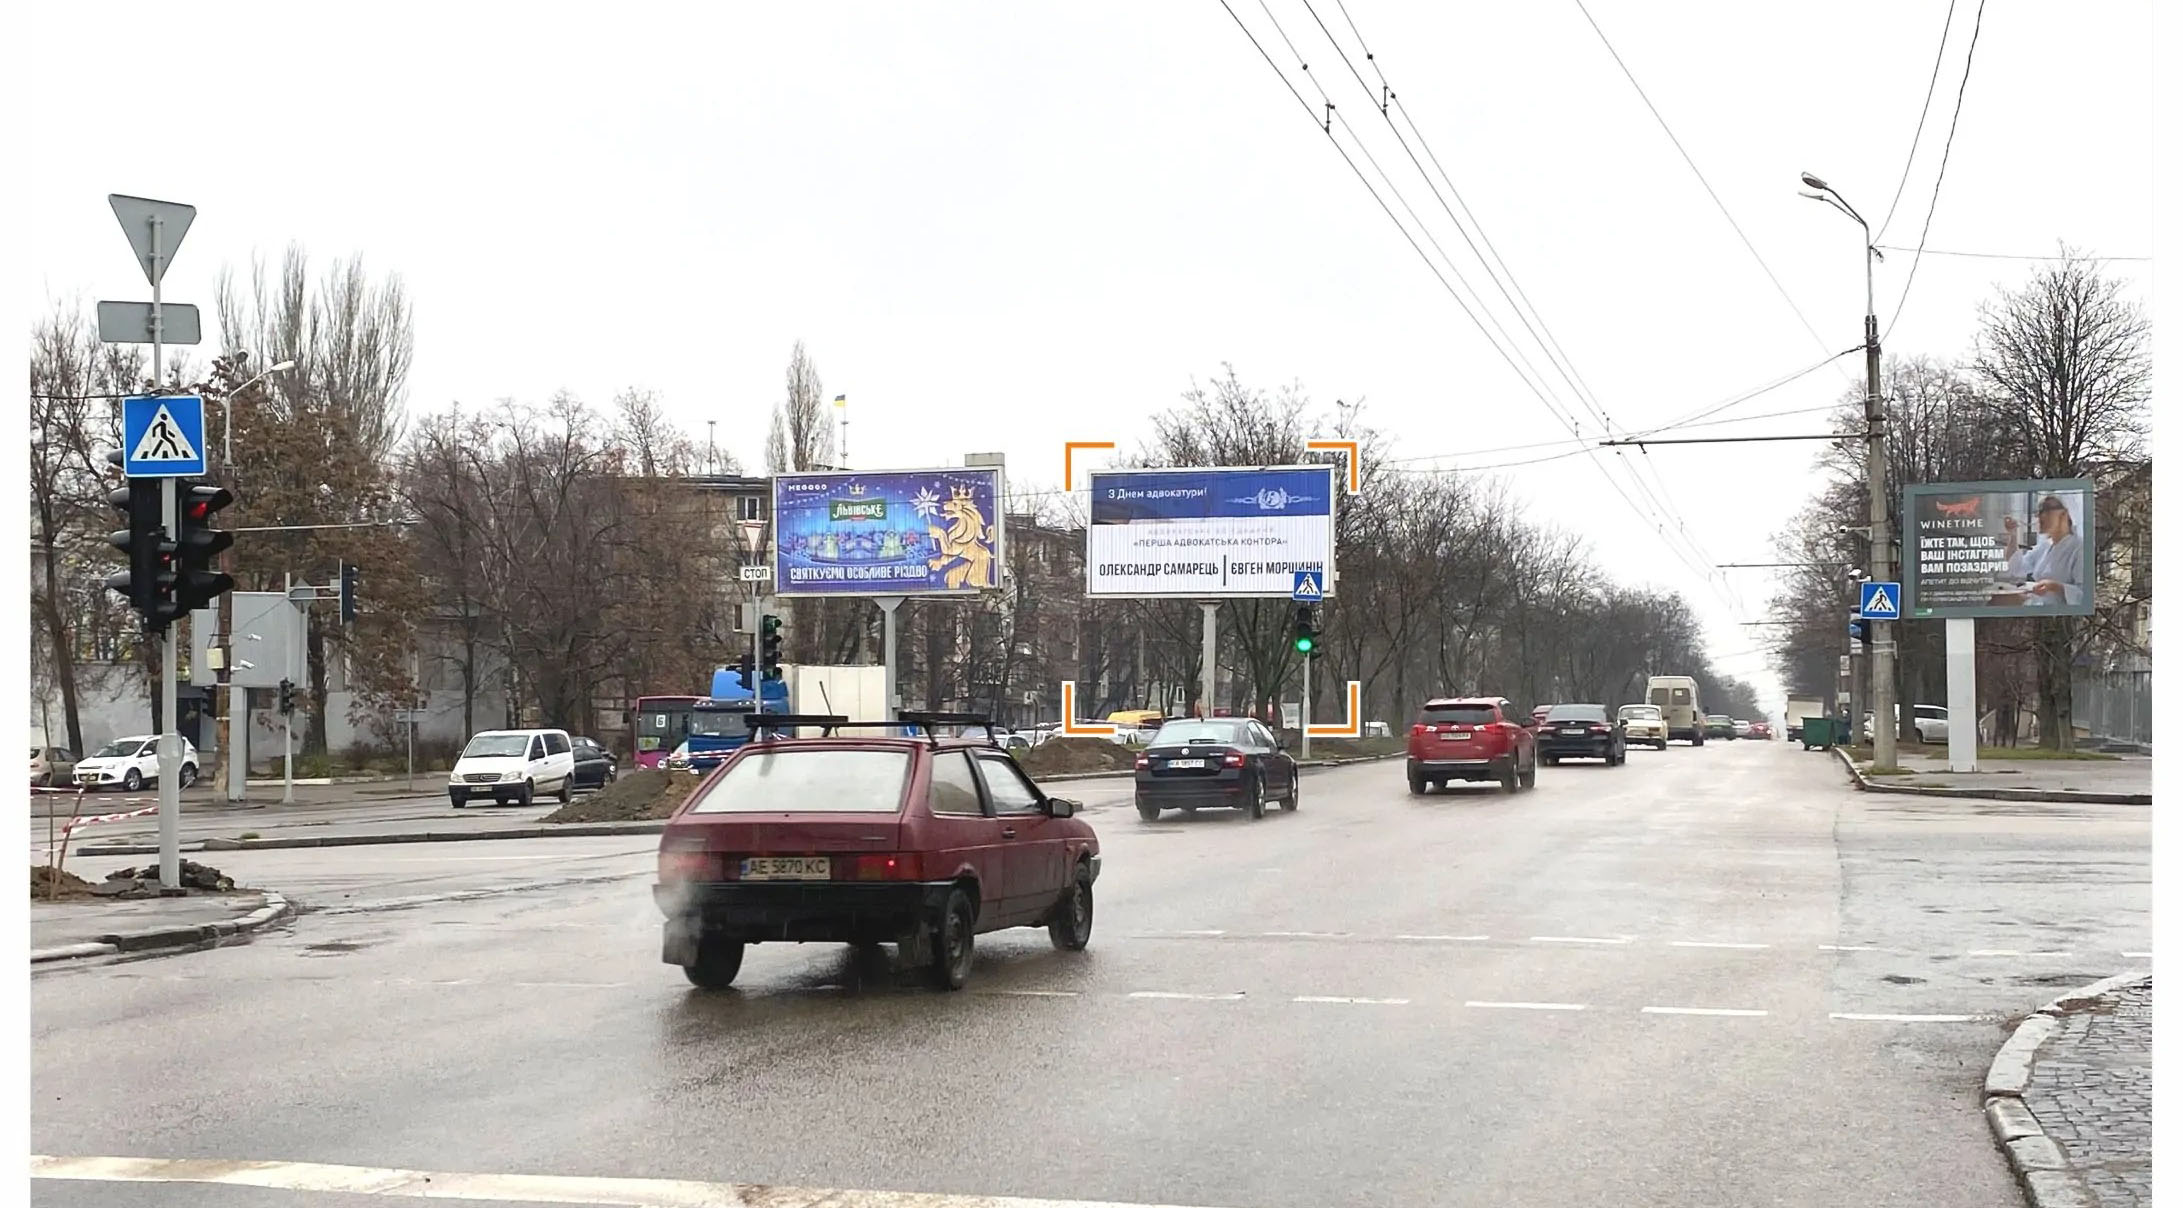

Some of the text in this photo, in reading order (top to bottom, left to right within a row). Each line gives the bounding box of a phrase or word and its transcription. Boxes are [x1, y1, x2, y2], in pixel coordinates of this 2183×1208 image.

[1108, 487, 1207, 500] З Днем адвокатури!
[1920, 518, 1984, 529] WINETIME
[1174, 538, 1238, 547] АДВОКАТСЬКА
[1920, 536, 1996, 549] ЇЖТЕ ТАК, ЩОБ
[1920, 549, 2004, 561] ВАШ ІНСТАГРАМ
[744, 568, 768, 579] СТОП
[790, 565, 928, 580] СВЯТКУЄМО ОСОБЛИВЕ РІЗДВО
[1099, 562, 1219, 577] ОЛЕКСАНДР САМАРЕЦЬ
[1231, 562, 1263, 575] ЄВГЕН
[1921, 561, 2009, 574] ВАМ ПОЗАЗДРИВ
[750, 859, 826, 875] AE 5870 KC
